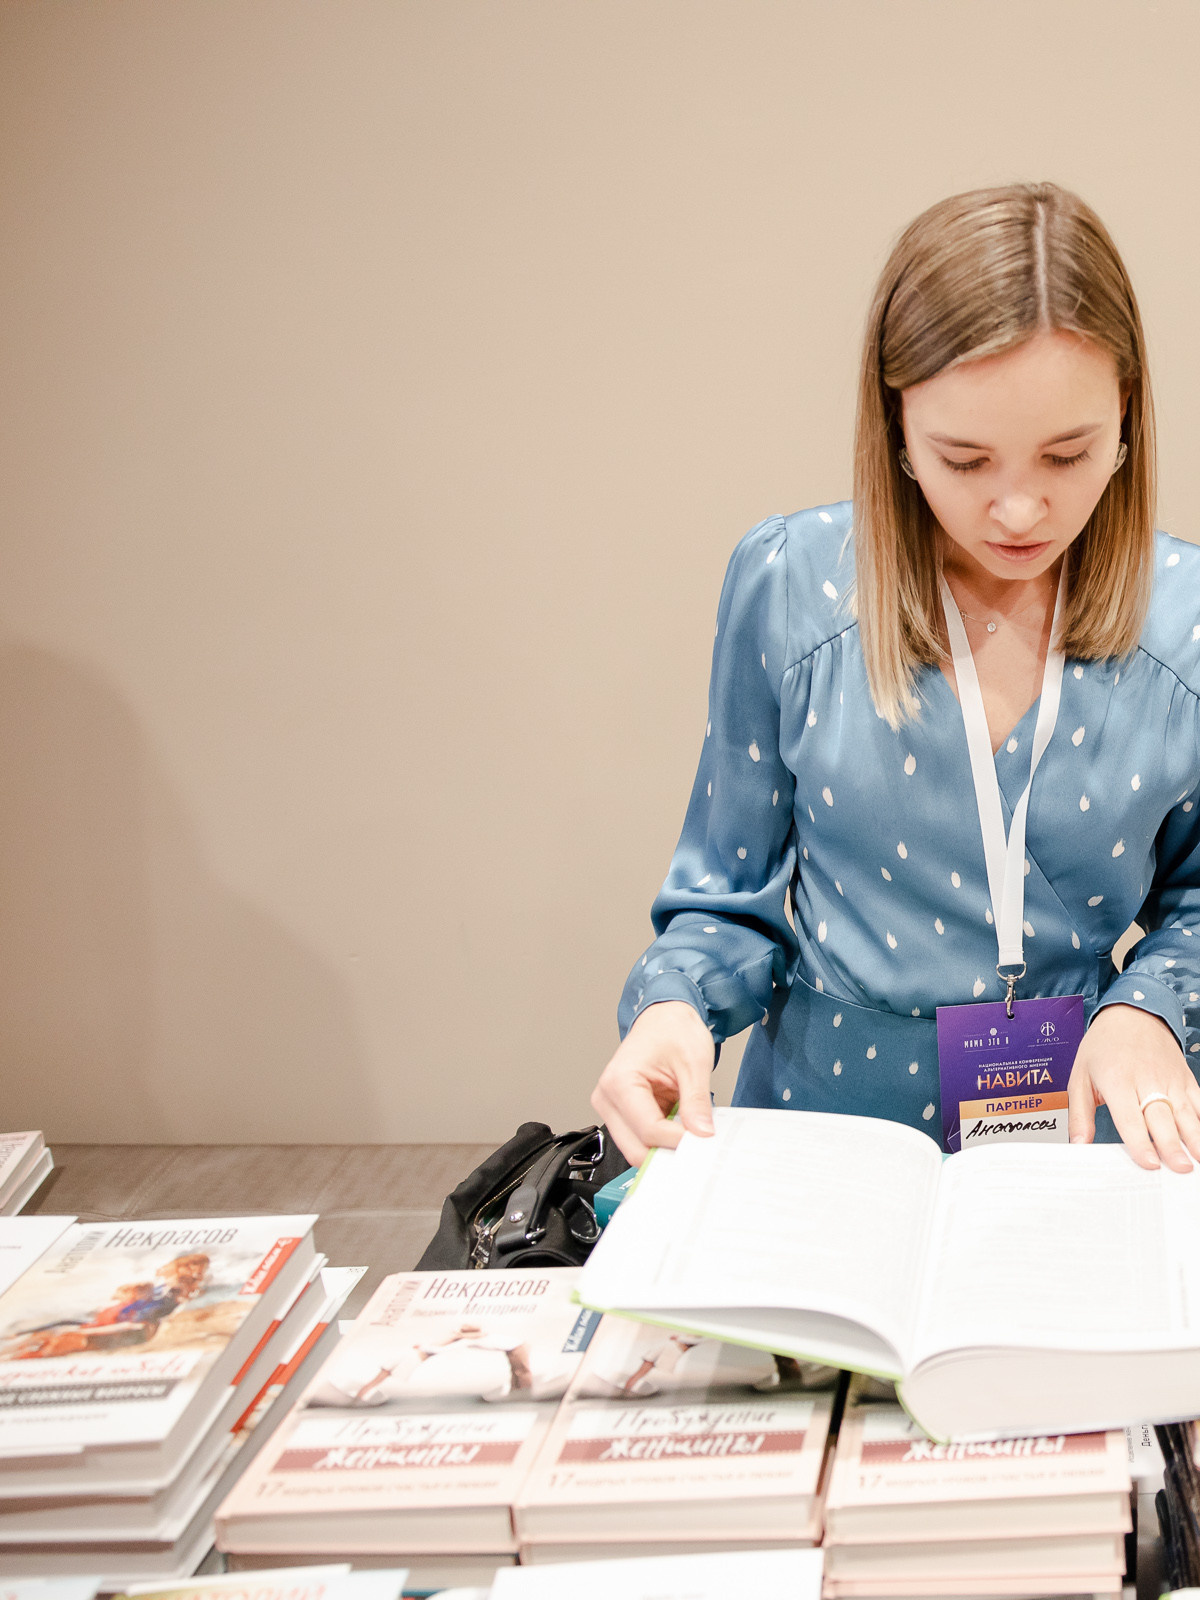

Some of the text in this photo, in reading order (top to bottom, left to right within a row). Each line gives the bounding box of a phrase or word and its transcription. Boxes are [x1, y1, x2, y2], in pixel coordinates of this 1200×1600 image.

[978, 1057, 1053, 1068] НАЦИОНАЛЬНАЯ КОНФЕРЕНЦИЯ
[984, 1064, 1028, 1072] АЛЬТЕРНАТИВНОГО
[977, 1068, 1054, 1090] НАВИТА
[986, 1097, 1043, 1112] ПАРТНЁР
[104, 1228, 239, 1251] Некрасов
[423, 1278, 550, 1302] Некрасов
